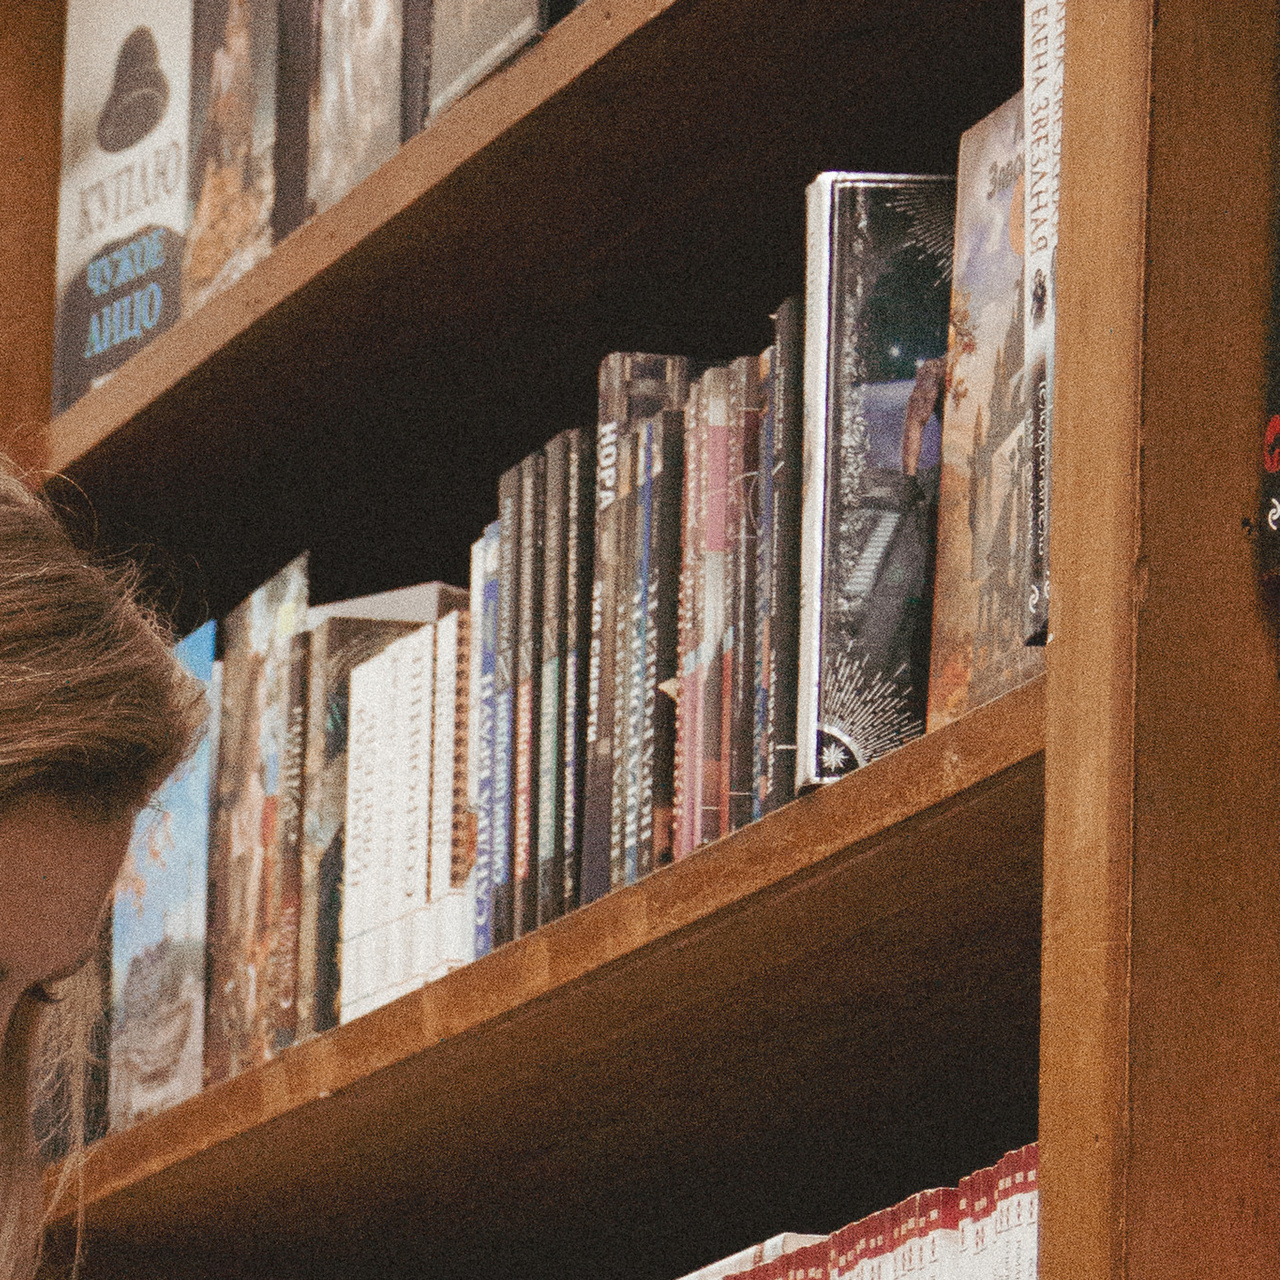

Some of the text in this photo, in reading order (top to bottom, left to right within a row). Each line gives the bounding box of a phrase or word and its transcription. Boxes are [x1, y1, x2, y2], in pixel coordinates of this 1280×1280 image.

[1030, 3, 1051, 257] ЕЛЕНА ЗВЕЗДНАЯ
[86, 228, 166, 298] ЧУЖОЕ
[83, 281, 163, 359] ЛИЦО
[598, 420, 619, 511] НОРА
[587, 638, 601, 743] СМЕРТИ
[475, 671, 495, 927] САНДРА БРАУН
[493, 693, 511, 884] СИДНИ ШЕЛДОН
